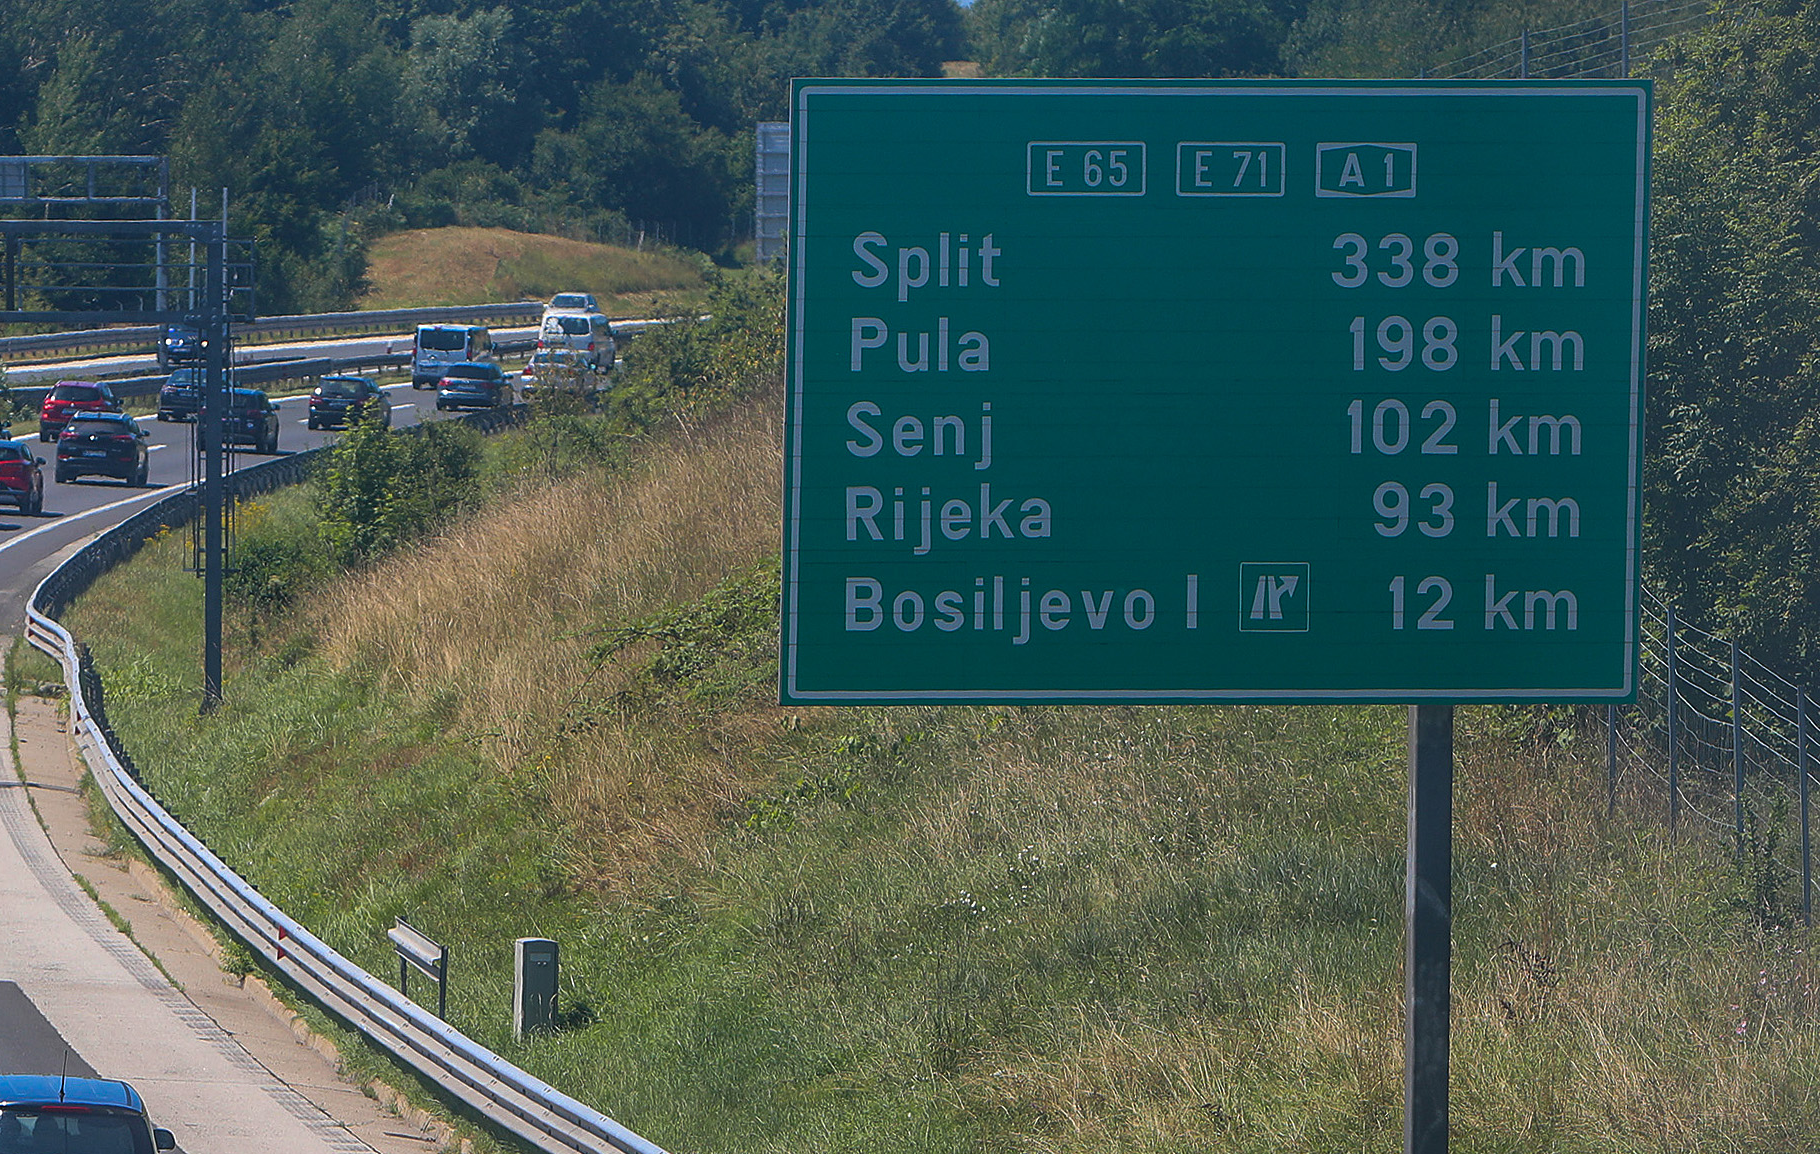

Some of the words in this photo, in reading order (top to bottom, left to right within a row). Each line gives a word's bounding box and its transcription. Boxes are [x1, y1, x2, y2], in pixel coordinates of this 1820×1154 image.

[1047, 151, 1063, 186] E
[1085, 150, 1126, 186] 65
[1196, 151, 1212, 186] E
[1234, 152, 1266, 187] 71
[1339, 153, 1364, 187] A
[1384, 154, 1394, 187] 1
[852, 232, 1001, 301] Split
[1332, 233, 1459, 288] 338
[1492, 232, 1585, 287] km
[852, 317, 989, 372] Pula
[1350, 316, 1458, 371] 198
[1492, 315, 1584, 371] km
[847, 402, 992, 470] Senj
[1348, 400, 1458, 454] 102
[1489, 399, 1582, 455] km
[847, 483, 1051, 555] Rijeka
[1374, 482, 1455, 538] 93
[1488, 482, 1580, 537] km
[846, 576, 1155, 645] Bosiljevo
[1186, 575, 1198, 630] I
[1390, 576, 1454, 630] 12
[1485, 574, 1578, 630] km
